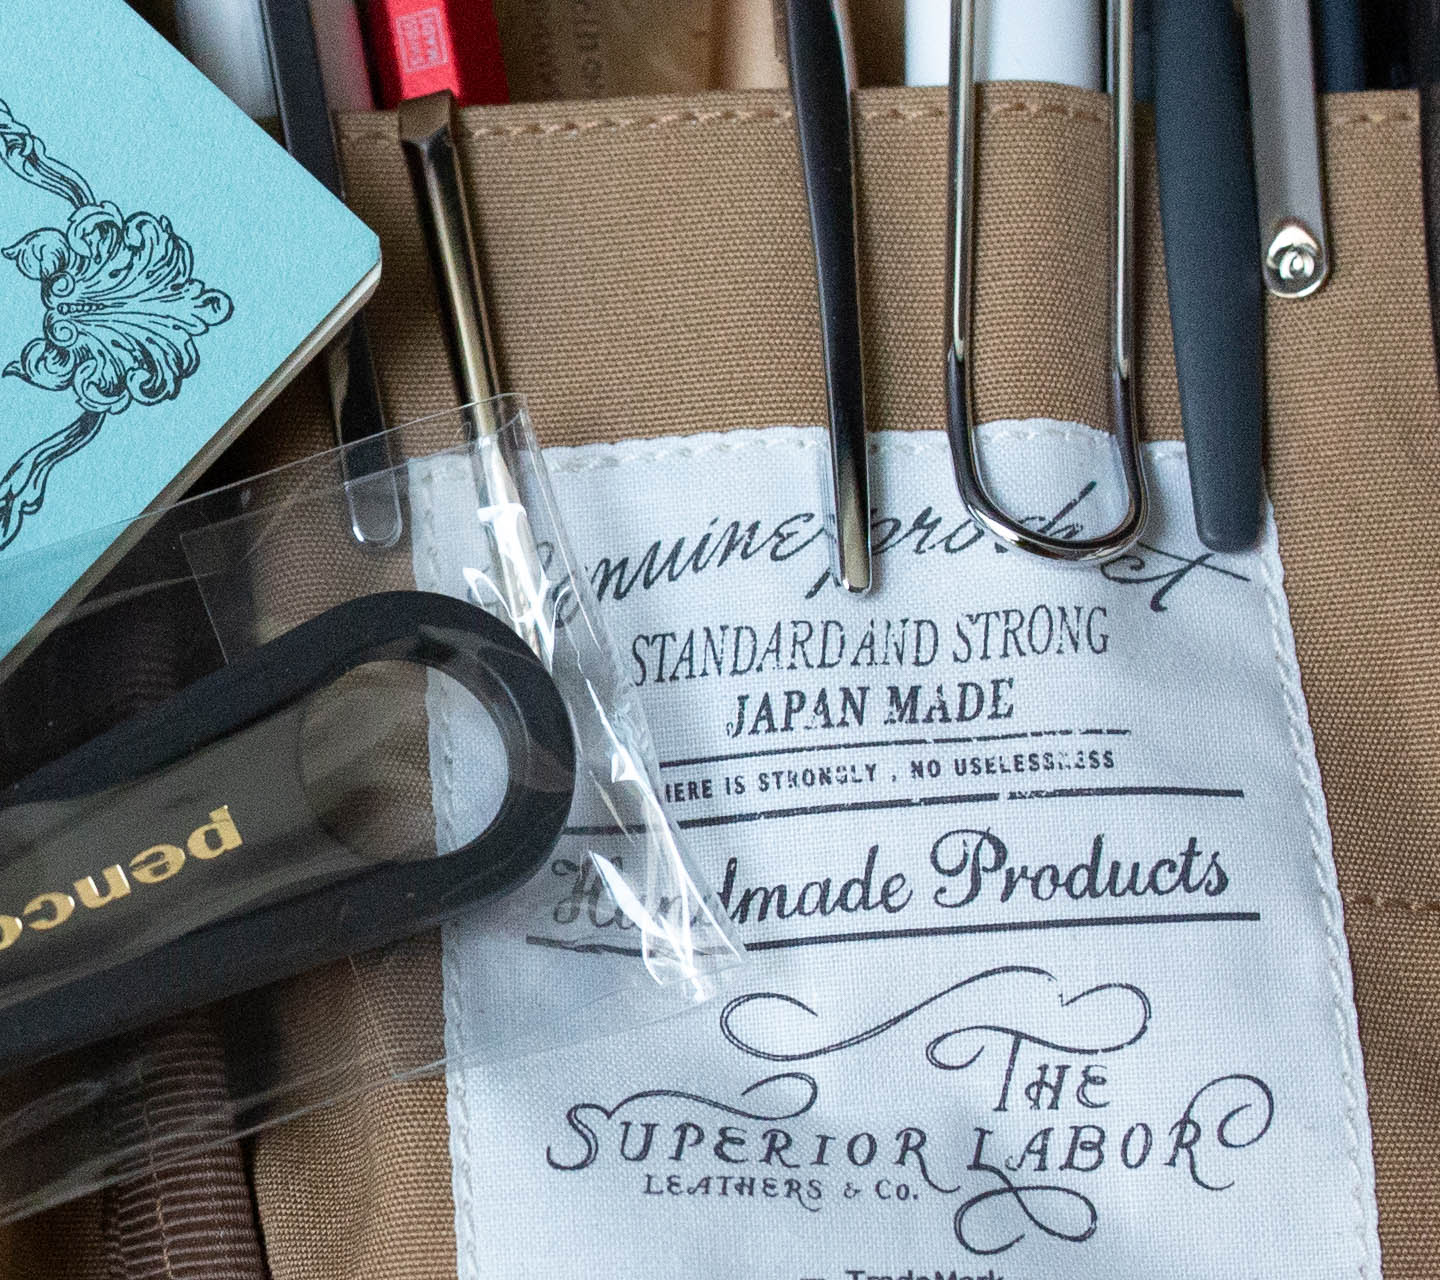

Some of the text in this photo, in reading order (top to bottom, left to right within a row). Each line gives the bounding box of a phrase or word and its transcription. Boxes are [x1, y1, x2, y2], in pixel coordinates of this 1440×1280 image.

[631, 604, 1112, 687] STANDARD AND STRONG
[726, 677, 1016, 738] JAPAN MADE
[726, 775, 746, 796] IS
[910, 759, 942, 780] NO
[928, 827, 1230, 910] Products
[546, 1103, 960, 1192] SUPERIOR
[643, 1173, 824, 1211] LEATHERS
